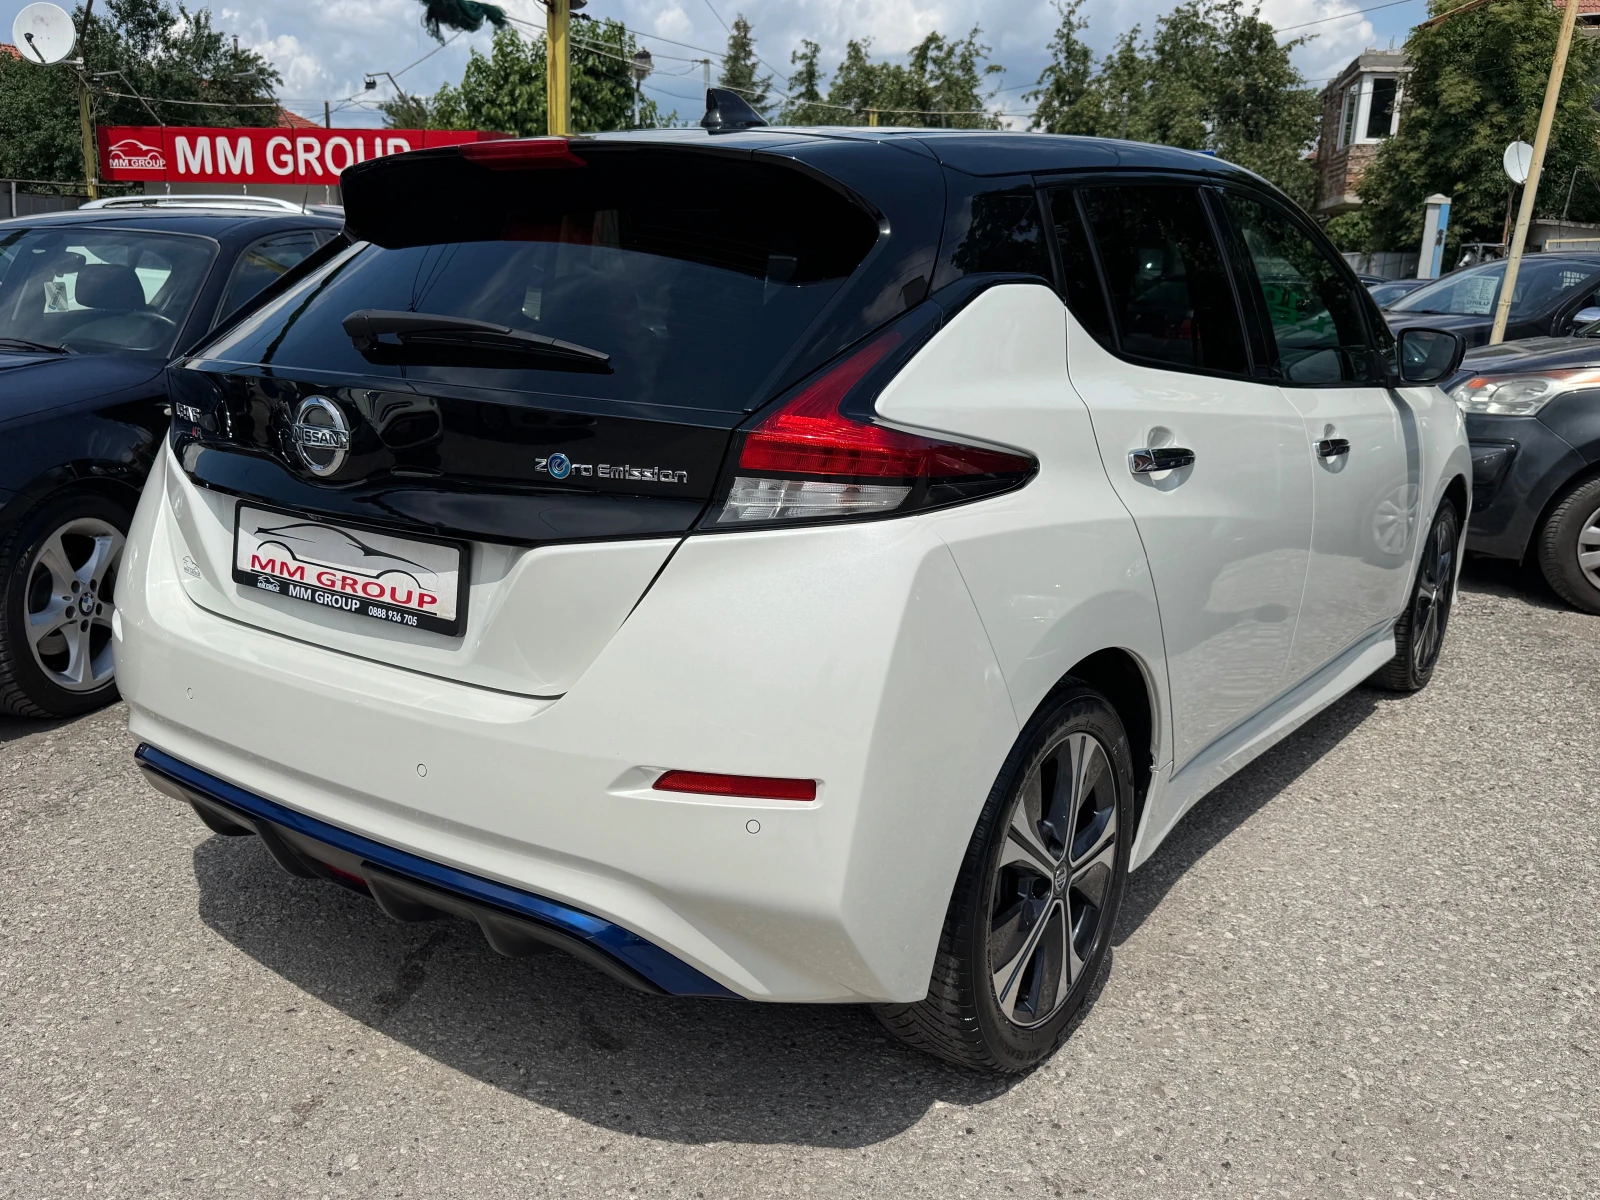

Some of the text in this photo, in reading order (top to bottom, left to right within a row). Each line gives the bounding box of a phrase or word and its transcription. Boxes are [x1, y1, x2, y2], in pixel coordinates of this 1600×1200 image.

[109, 158, 166, 168] MM GROUP
[175, 135, 254, 176] MM
[293, 425, 341, 447] NISSAN
[535, 453, 593, 480] zero
[251, 554, 438, 608] MM GROUP
[289, 584, 312, 601] MM
[315, 591, 360, 612] GROUP
[368, 605, 387, 619] 0888
[388, 610, 402, 623] 936
[403, 614, 418, 626] 705
